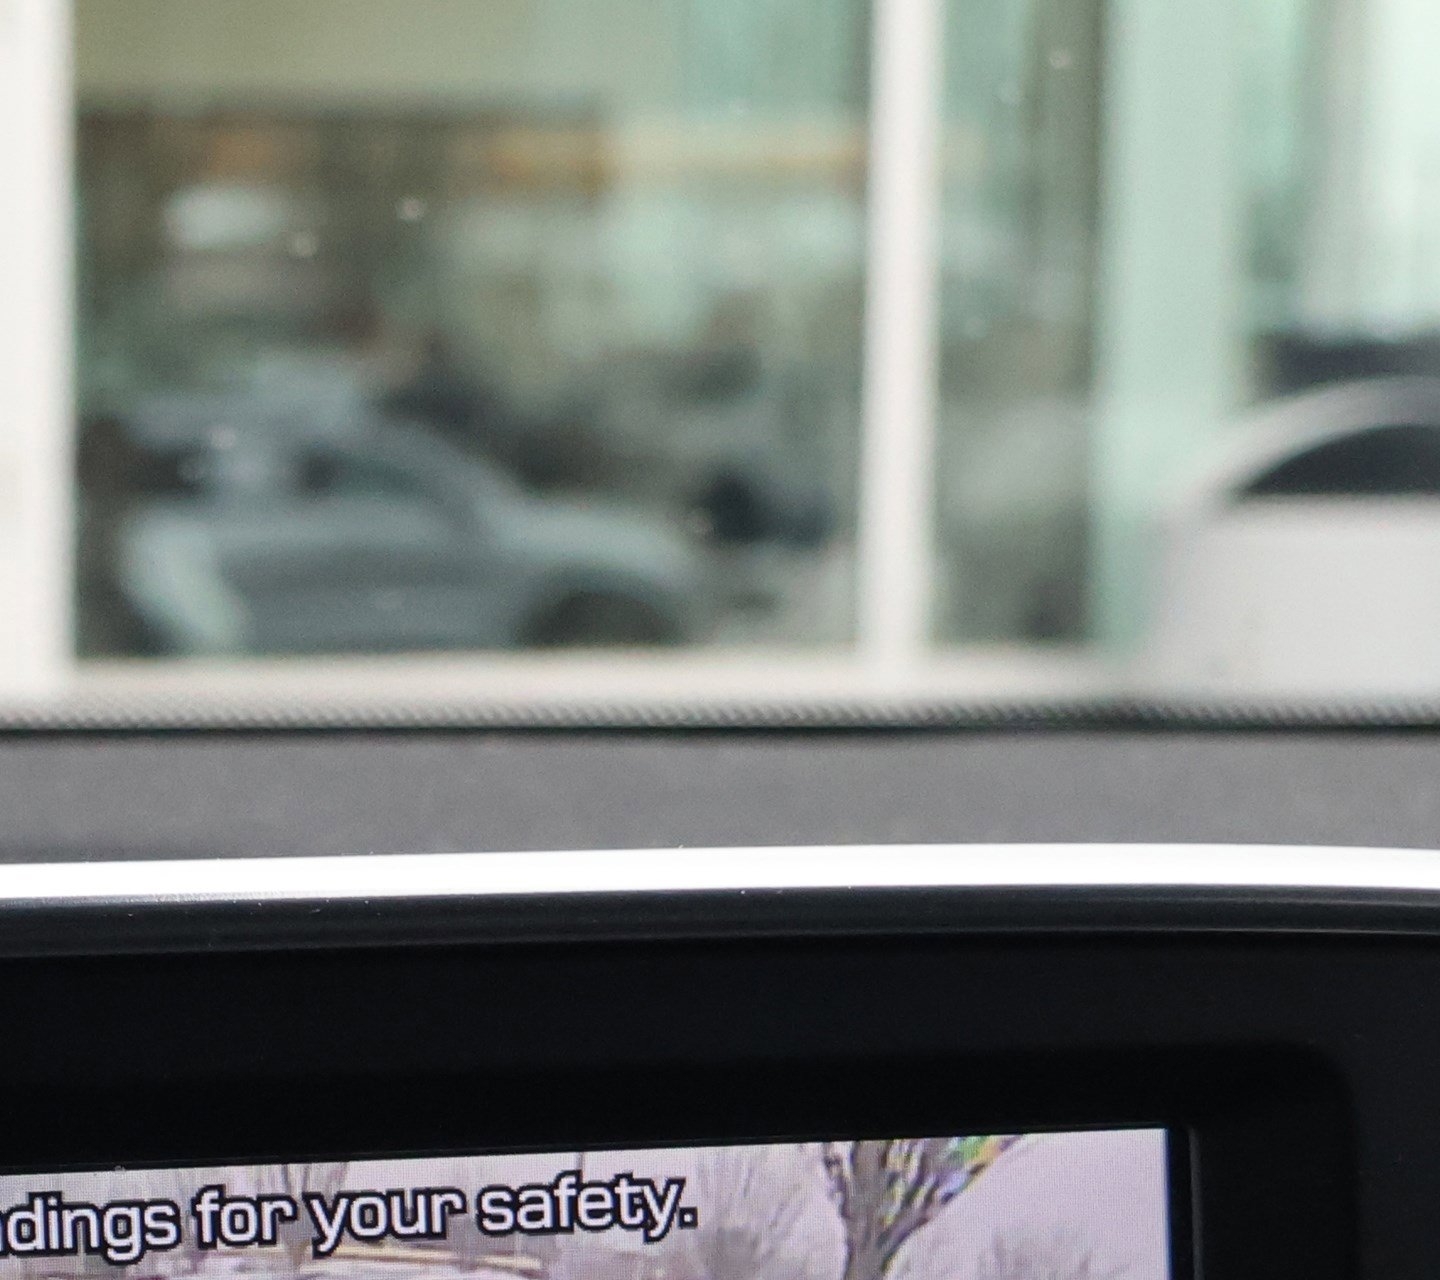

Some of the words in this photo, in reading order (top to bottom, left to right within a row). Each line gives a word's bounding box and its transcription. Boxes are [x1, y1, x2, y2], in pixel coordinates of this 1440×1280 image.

[192, 1184, 297, 1249] for
[308, 1187, 467, 1259] your
[476, 1169, 698, 1243] safety.
